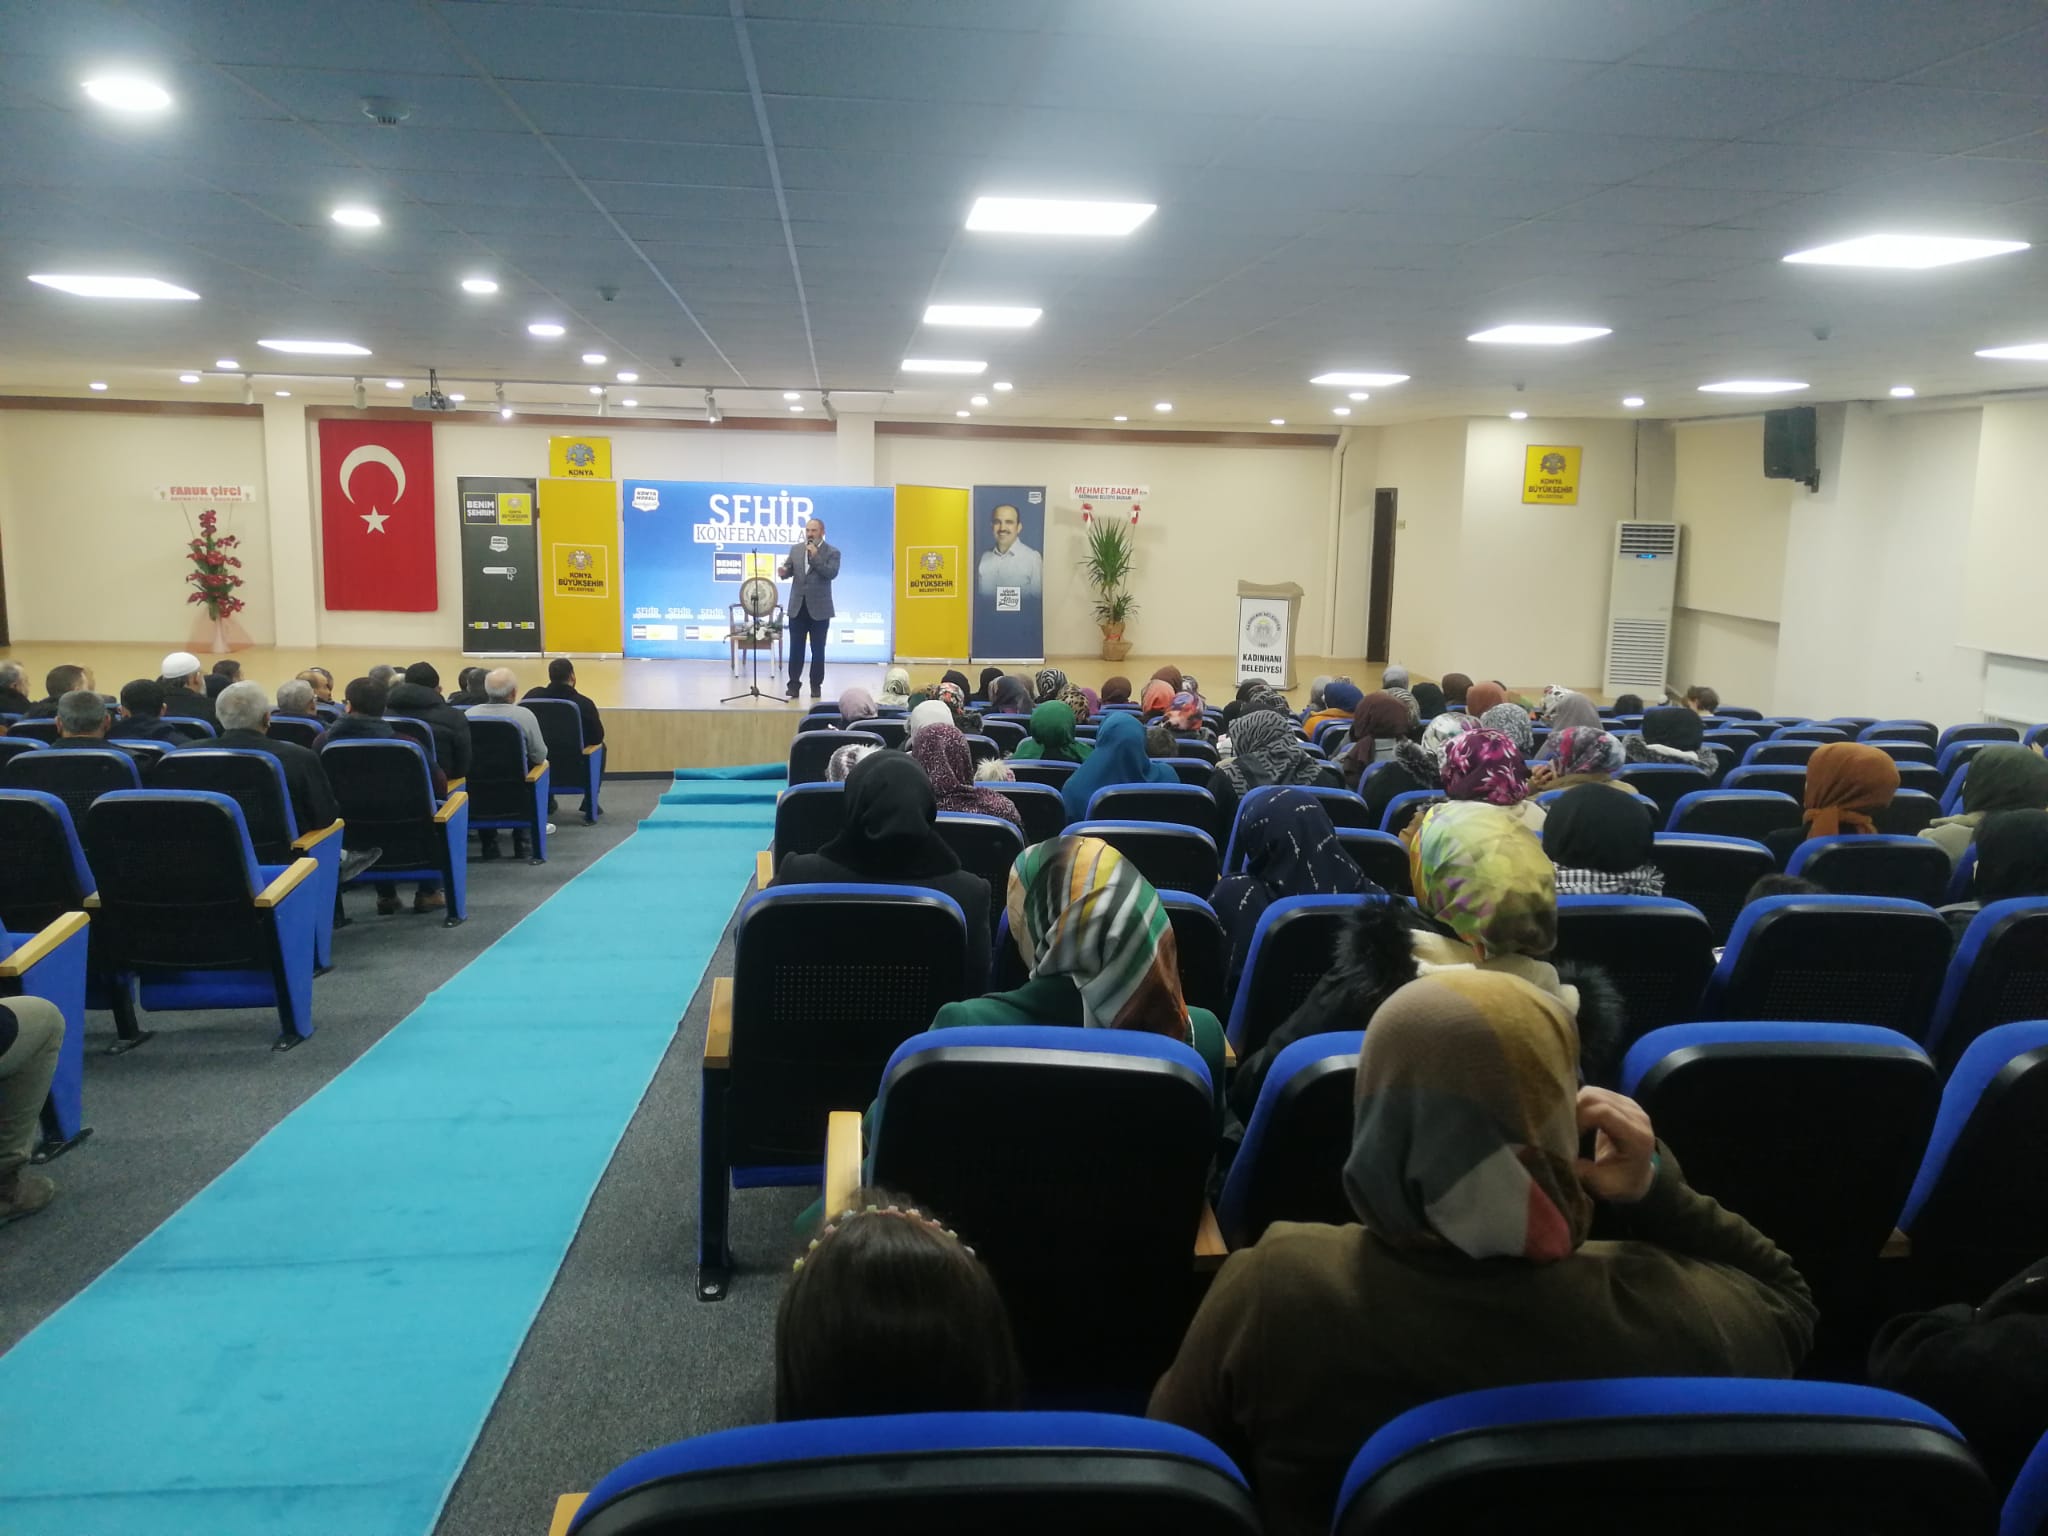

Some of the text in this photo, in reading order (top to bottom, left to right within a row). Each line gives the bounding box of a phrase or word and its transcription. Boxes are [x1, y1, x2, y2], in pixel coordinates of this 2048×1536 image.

[1075, 486, 1110, 495] MEHMET
[467, 501, 494, 509] BENİM
[696, 526, 807, 543] KONFERANSLA
[1242, 653, 1282, 663] KADINHANI
[1241, 664, 1282, 674] BELEDİYESİ
